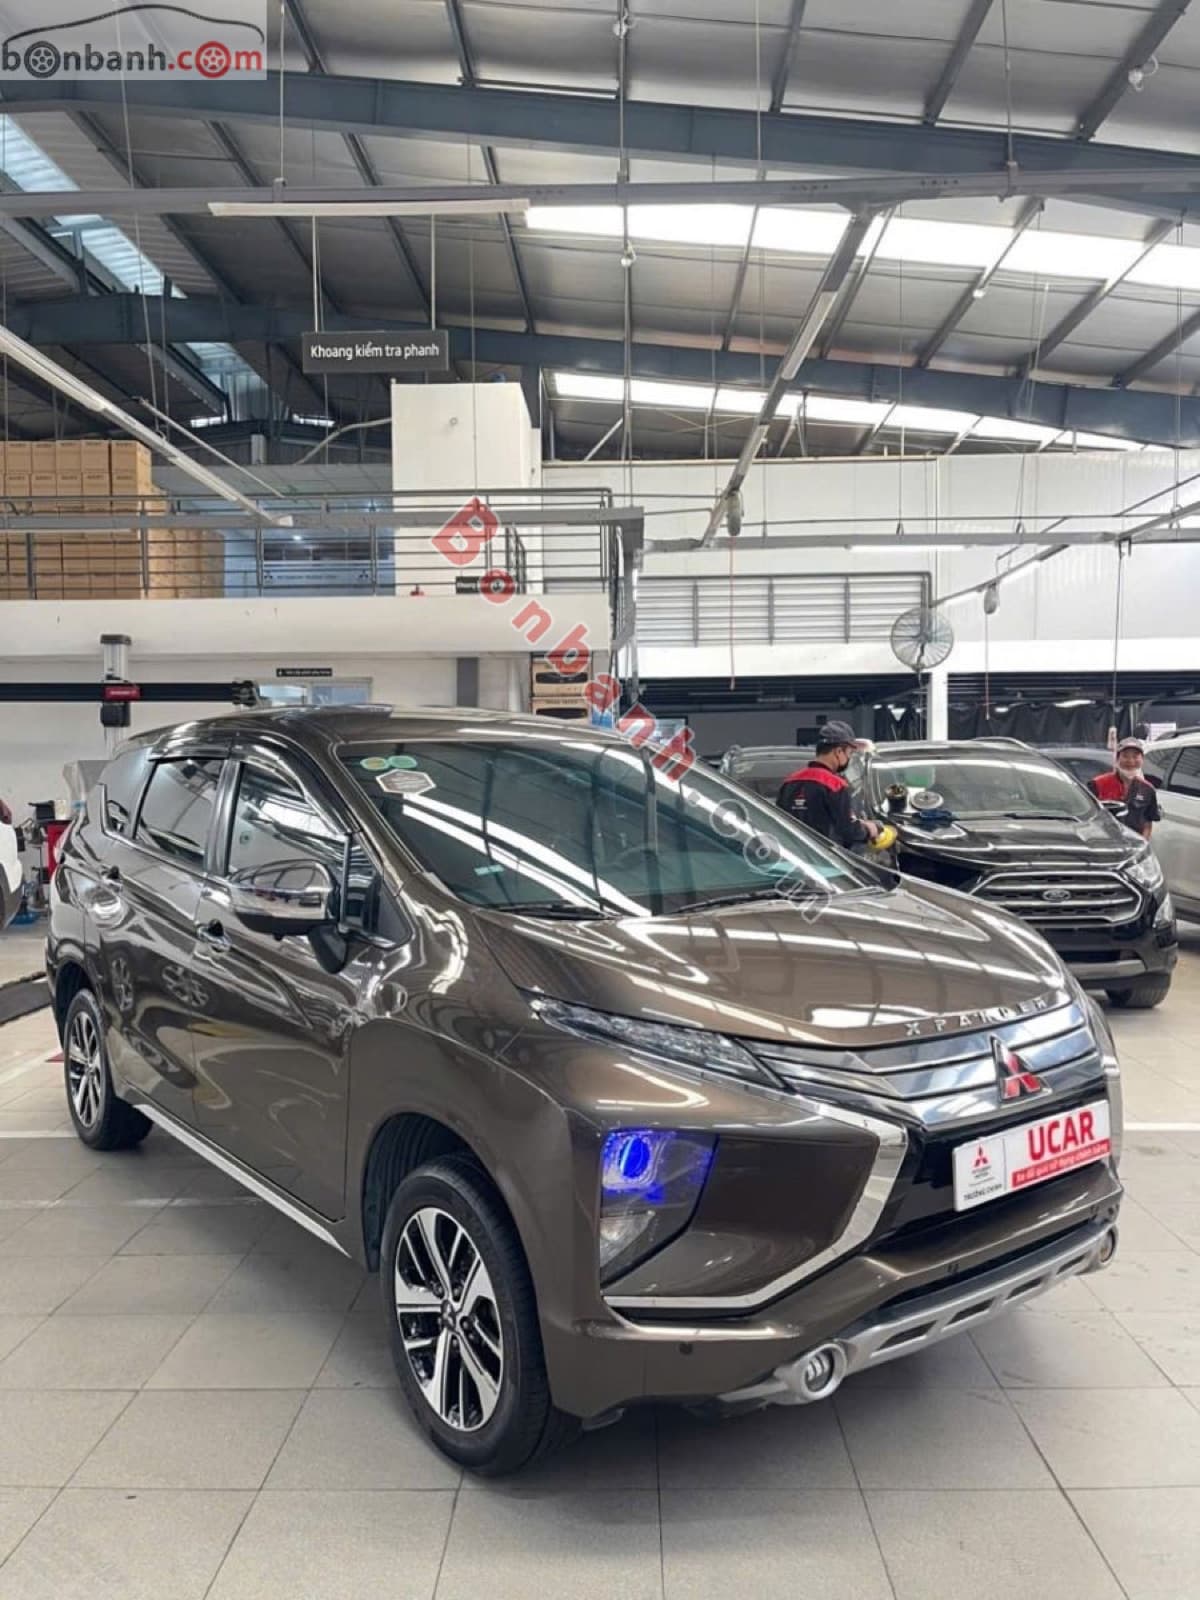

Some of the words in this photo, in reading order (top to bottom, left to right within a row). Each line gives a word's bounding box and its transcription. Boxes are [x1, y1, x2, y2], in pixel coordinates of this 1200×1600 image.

[310, 344, 353, 361] Khoang
[355, 340, 383, 358] kiểm
[385, 343, 401, 358] tra
[404, 343, 440, 361] phanh
[1027, 1110, 1095, 1162] UCAR
